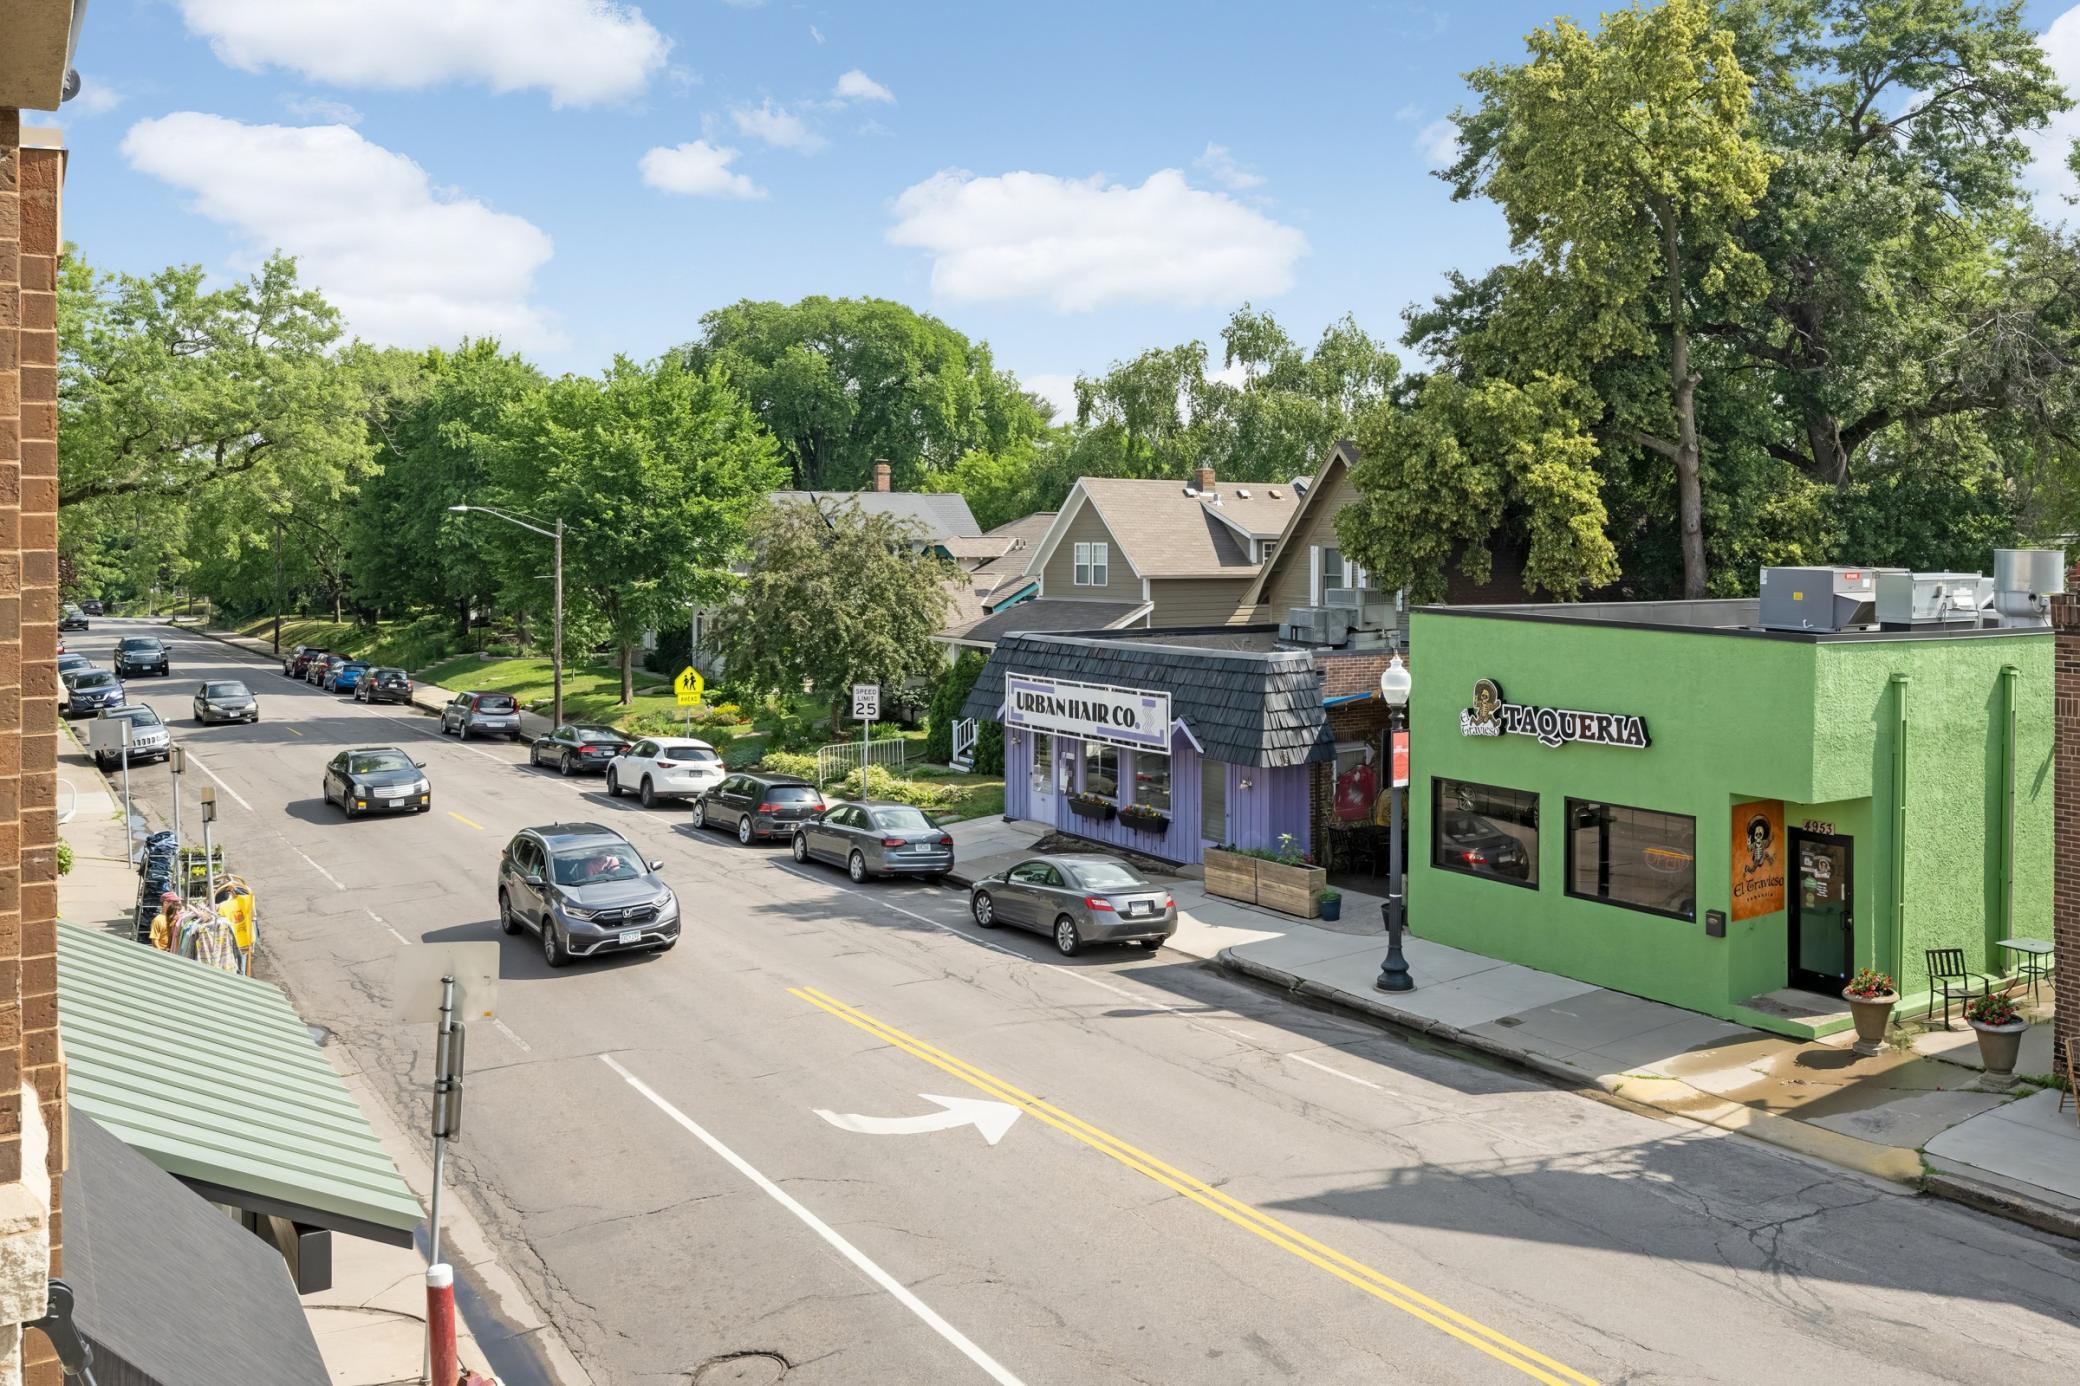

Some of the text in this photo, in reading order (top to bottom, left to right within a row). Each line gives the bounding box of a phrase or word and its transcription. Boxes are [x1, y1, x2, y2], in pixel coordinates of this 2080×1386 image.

[855, 702, 877, 715] 25
[1016, 691, 1141, 730] URBAN HAIR CO.
[1502, 704, 1646, 747] TAQUERIA
[1804, 820, 1832, 836] 4953
[1733, 882, 1745, 897] El
